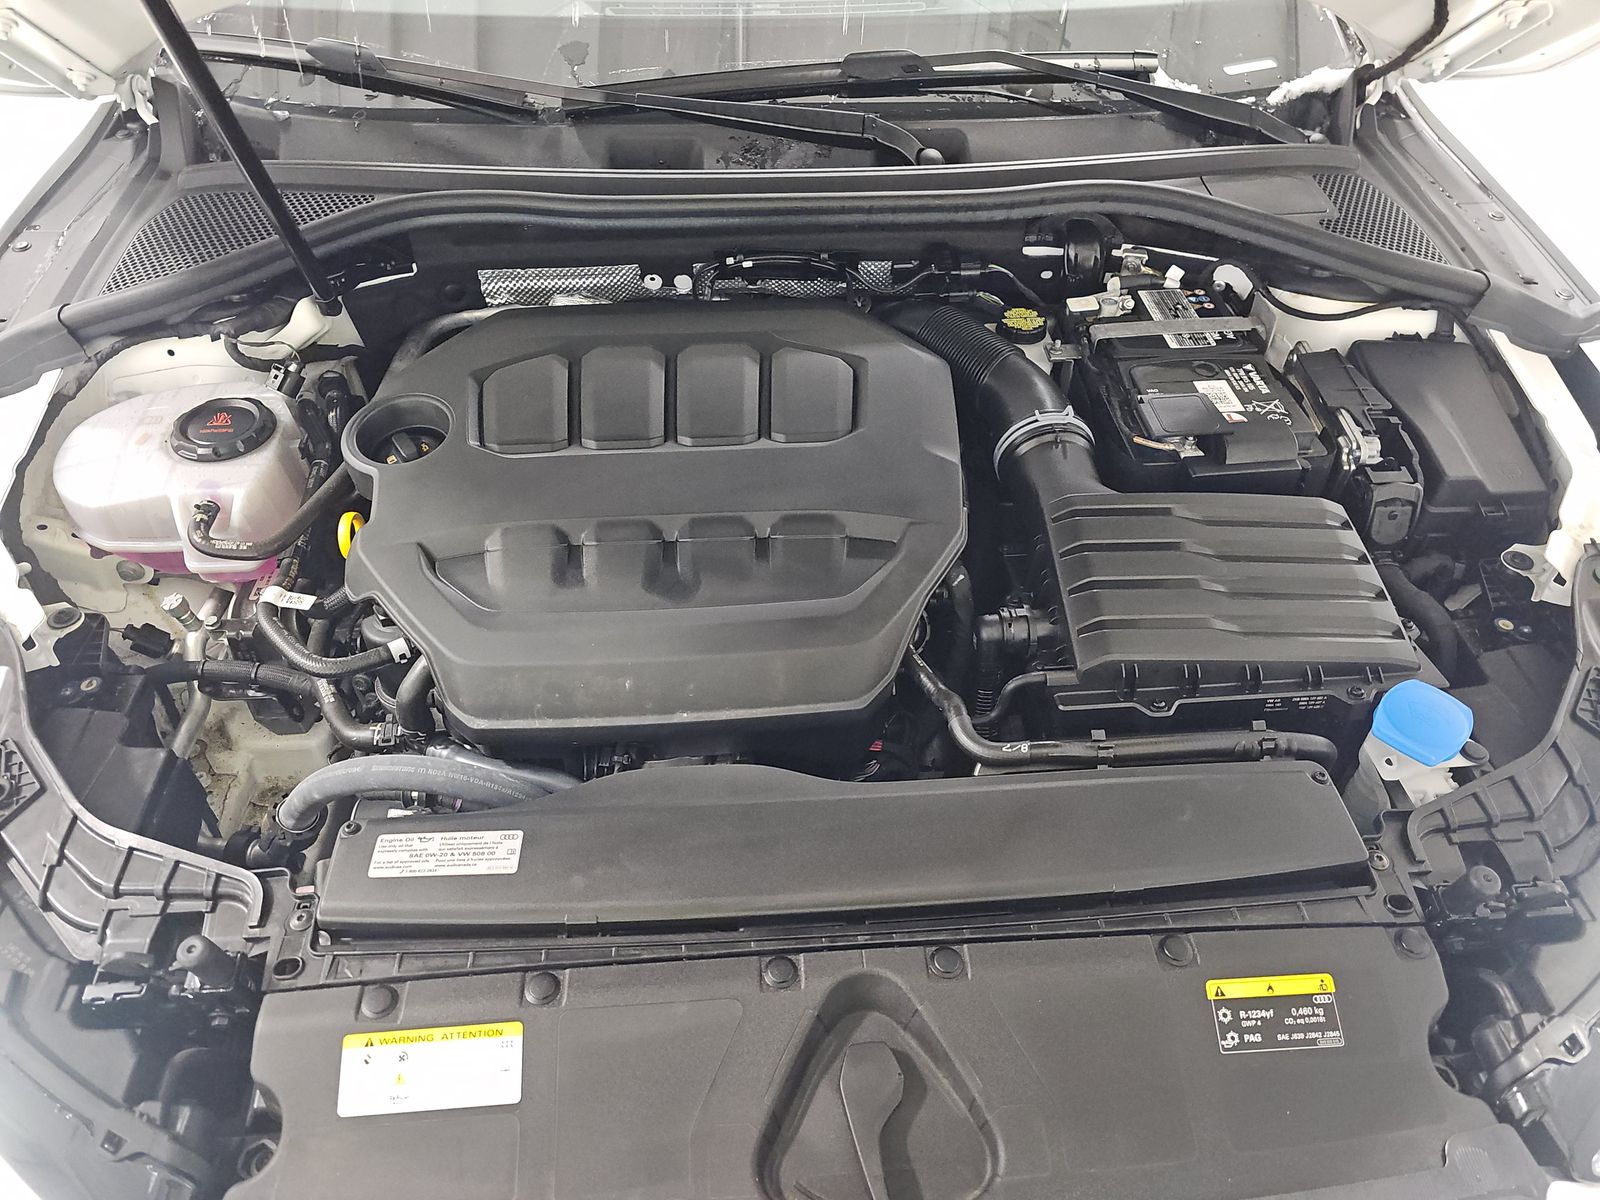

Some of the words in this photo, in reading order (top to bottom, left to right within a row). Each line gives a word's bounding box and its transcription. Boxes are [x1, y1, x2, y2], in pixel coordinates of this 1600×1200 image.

[1249, 371, 1271, 394] VARTA
[1239, 1009, 1274, 1020] R-1234yf
[1314, 1006, 1324, 1016] kg
[379, 1033, 434, 1046] WARNING
[441, 1029, 504, 1041] ATTENTION
[1243, 1033, 1262, 1043] PAG
[1277, 1033, 1290, 1041] SAE
